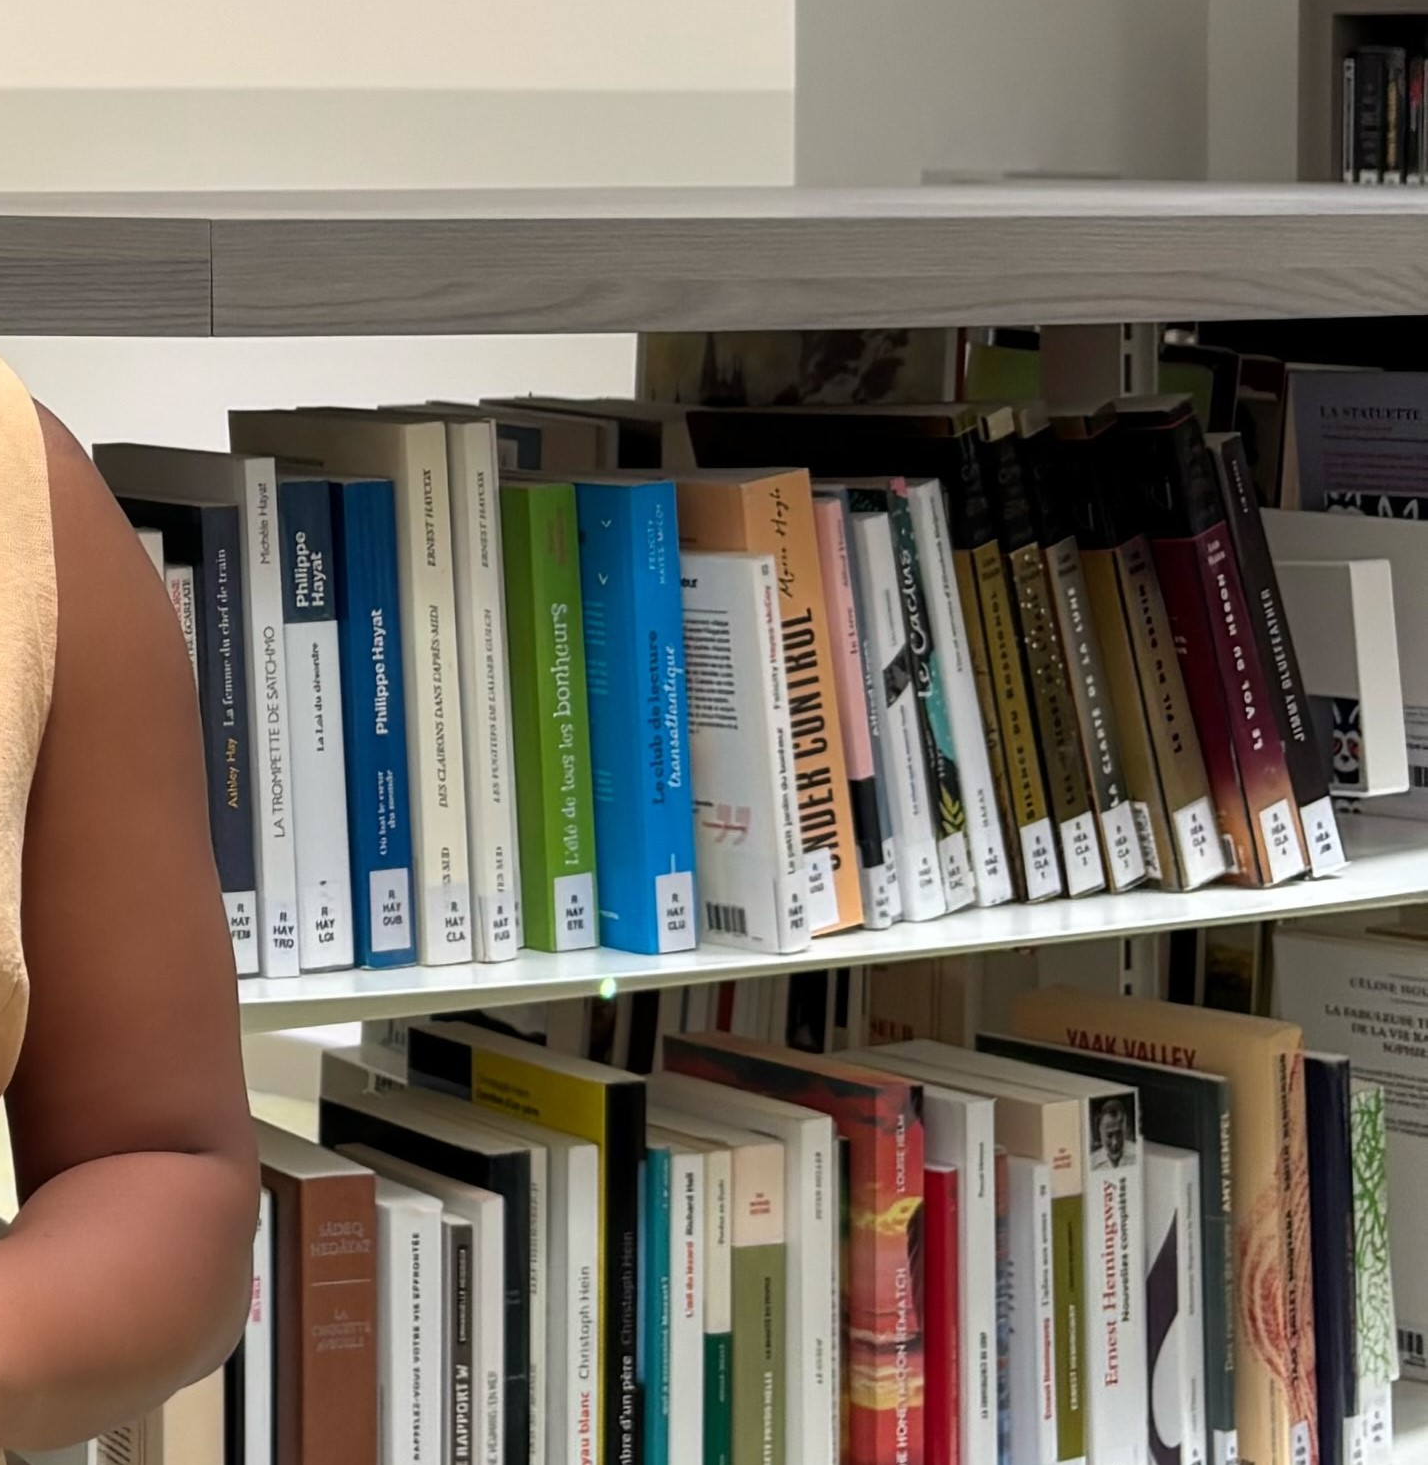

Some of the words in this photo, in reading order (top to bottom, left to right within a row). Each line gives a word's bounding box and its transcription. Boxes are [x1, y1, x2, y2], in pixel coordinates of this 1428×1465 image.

[294, 531, 311, 607] Philippe
[309, 551, 327, 607] Hayat
[262, 625, 279, 700] SATCHMO
[370, 608, 386, 661] Hayat
[548, 602, 573, 717] bonheurs
[265, 702, 280, 723] DE
[374, 663, 391, 735] Philippe
[783, 607, 829, 759] CONTROL
[267, 727, 285, 815] TROMPETTE
[557, 754, 575, 791] tous
[271, 817, 286, 838] LA
[559, 797, 576, 819] de
[1123, 1038, 1197, 1069] VALLEY
[1099, 1179, 1121, 1311] Hemingway
[578, 1266, 591, 1301] Hein
[577, 1305, 593, 1380] Christoph
[1102, 1319, 1121, 1388] Ernest
[577, 1392, 590, 1433] blanc
